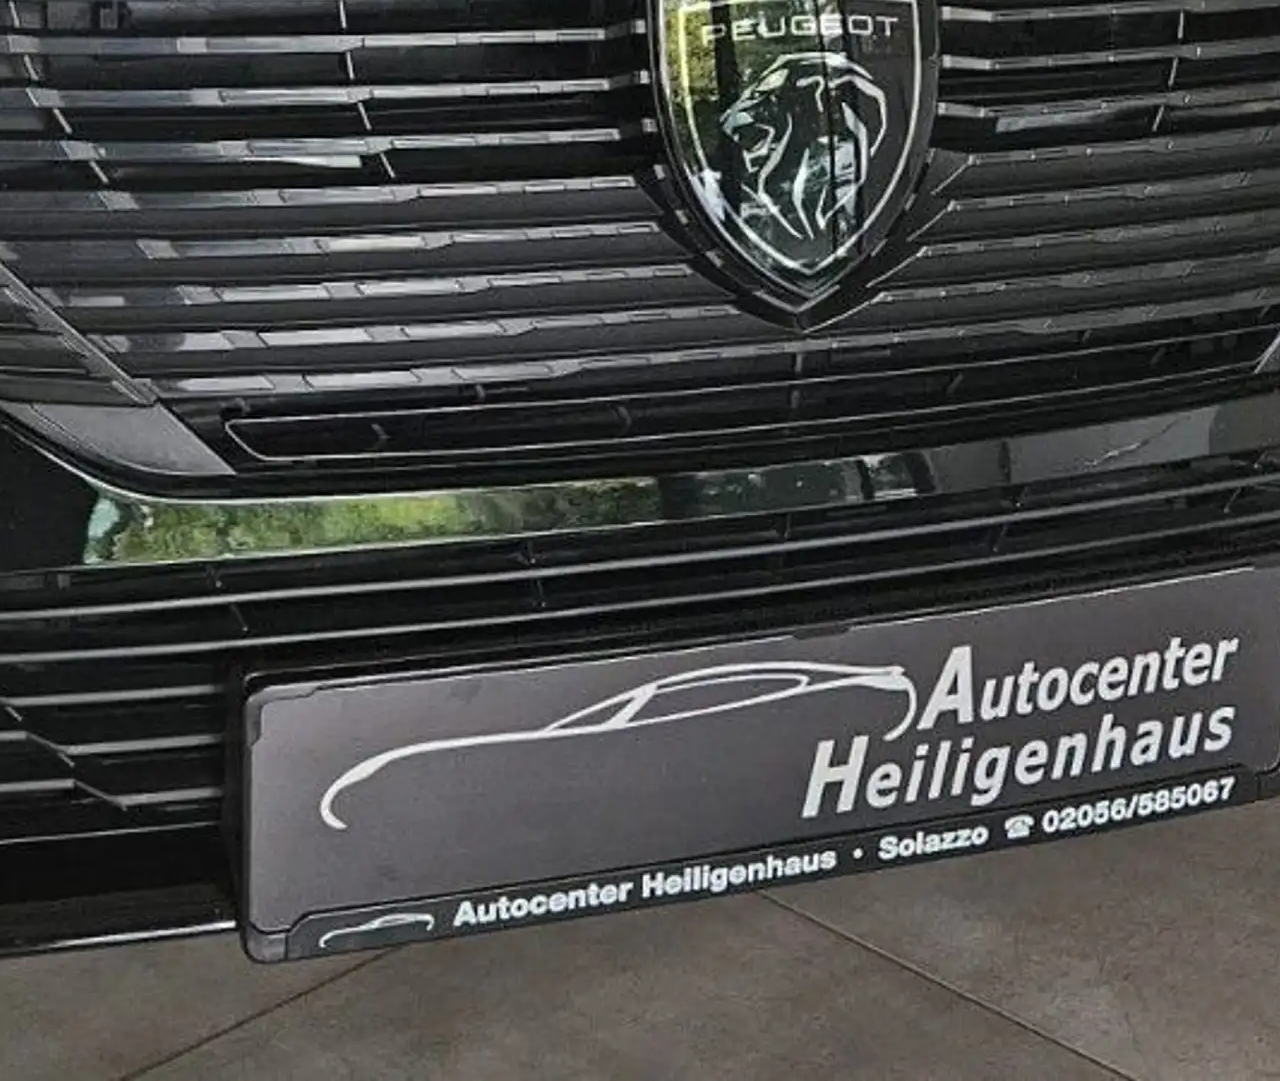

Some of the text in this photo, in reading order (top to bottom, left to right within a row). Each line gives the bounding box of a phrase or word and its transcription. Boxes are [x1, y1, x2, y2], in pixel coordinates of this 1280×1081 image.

[700, 13, 898, 47] PEUGEOT
[917, 636, 1238, 730] Autocenter
[800, 706, 1237, 818] Heiligenhaus
[453, 777, 1236, 928] Autocenter Heiligenhaus Solazzo 02056/585067
